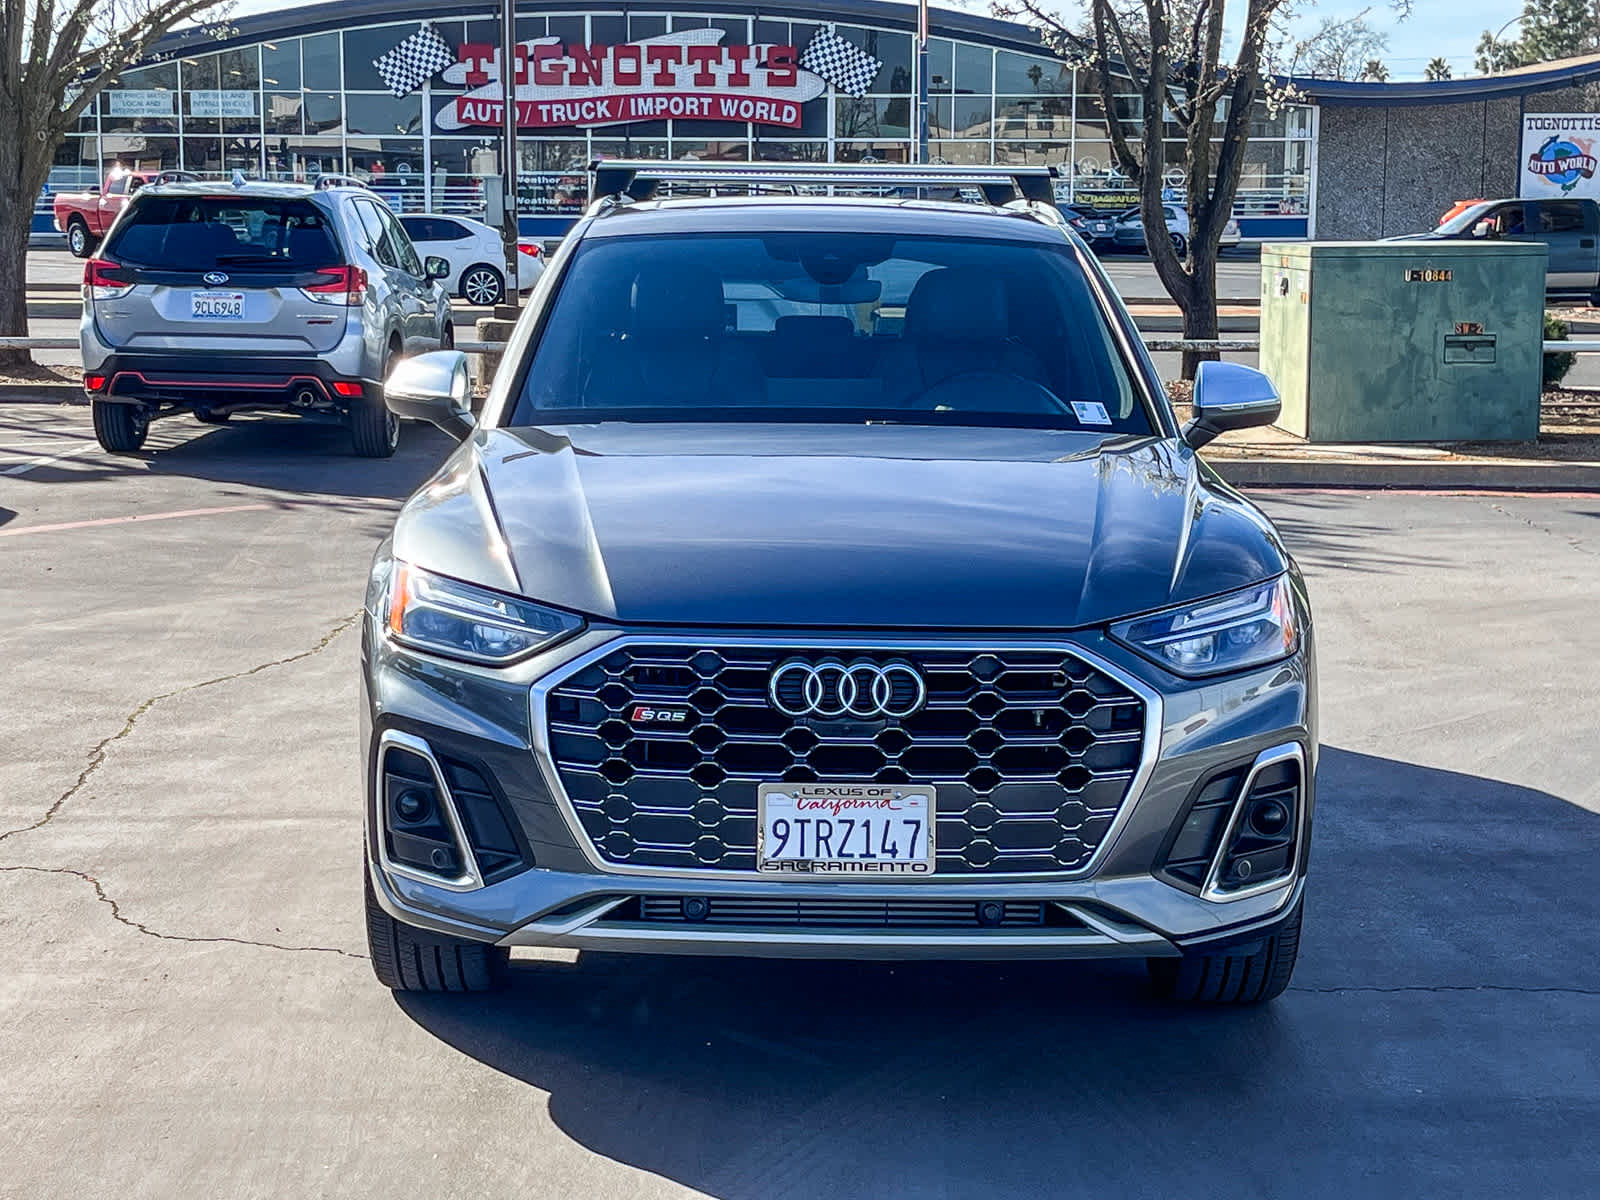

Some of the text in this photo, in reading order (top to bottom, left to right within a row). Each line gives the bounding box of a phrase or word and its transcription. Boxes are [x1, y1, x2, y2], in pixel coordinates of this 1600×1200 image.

[462, 102, 520, 122] AUT
[538, 100, 612, 122] TRUCK
[630, 97, 713, 117] IMPORT
[719, 98, 797, 123] WORLD
[1530, 157, 1595, 174] AUTO WORLD
[193, 301, 242, 316] 9CLG948
[801, 787, 893, 797] LEXUS OF
[796, 797, 903, 816] California
[771, 818, 922, 859] 9TRZ147
[763, 861, 929, 873] SACRAMENTO
